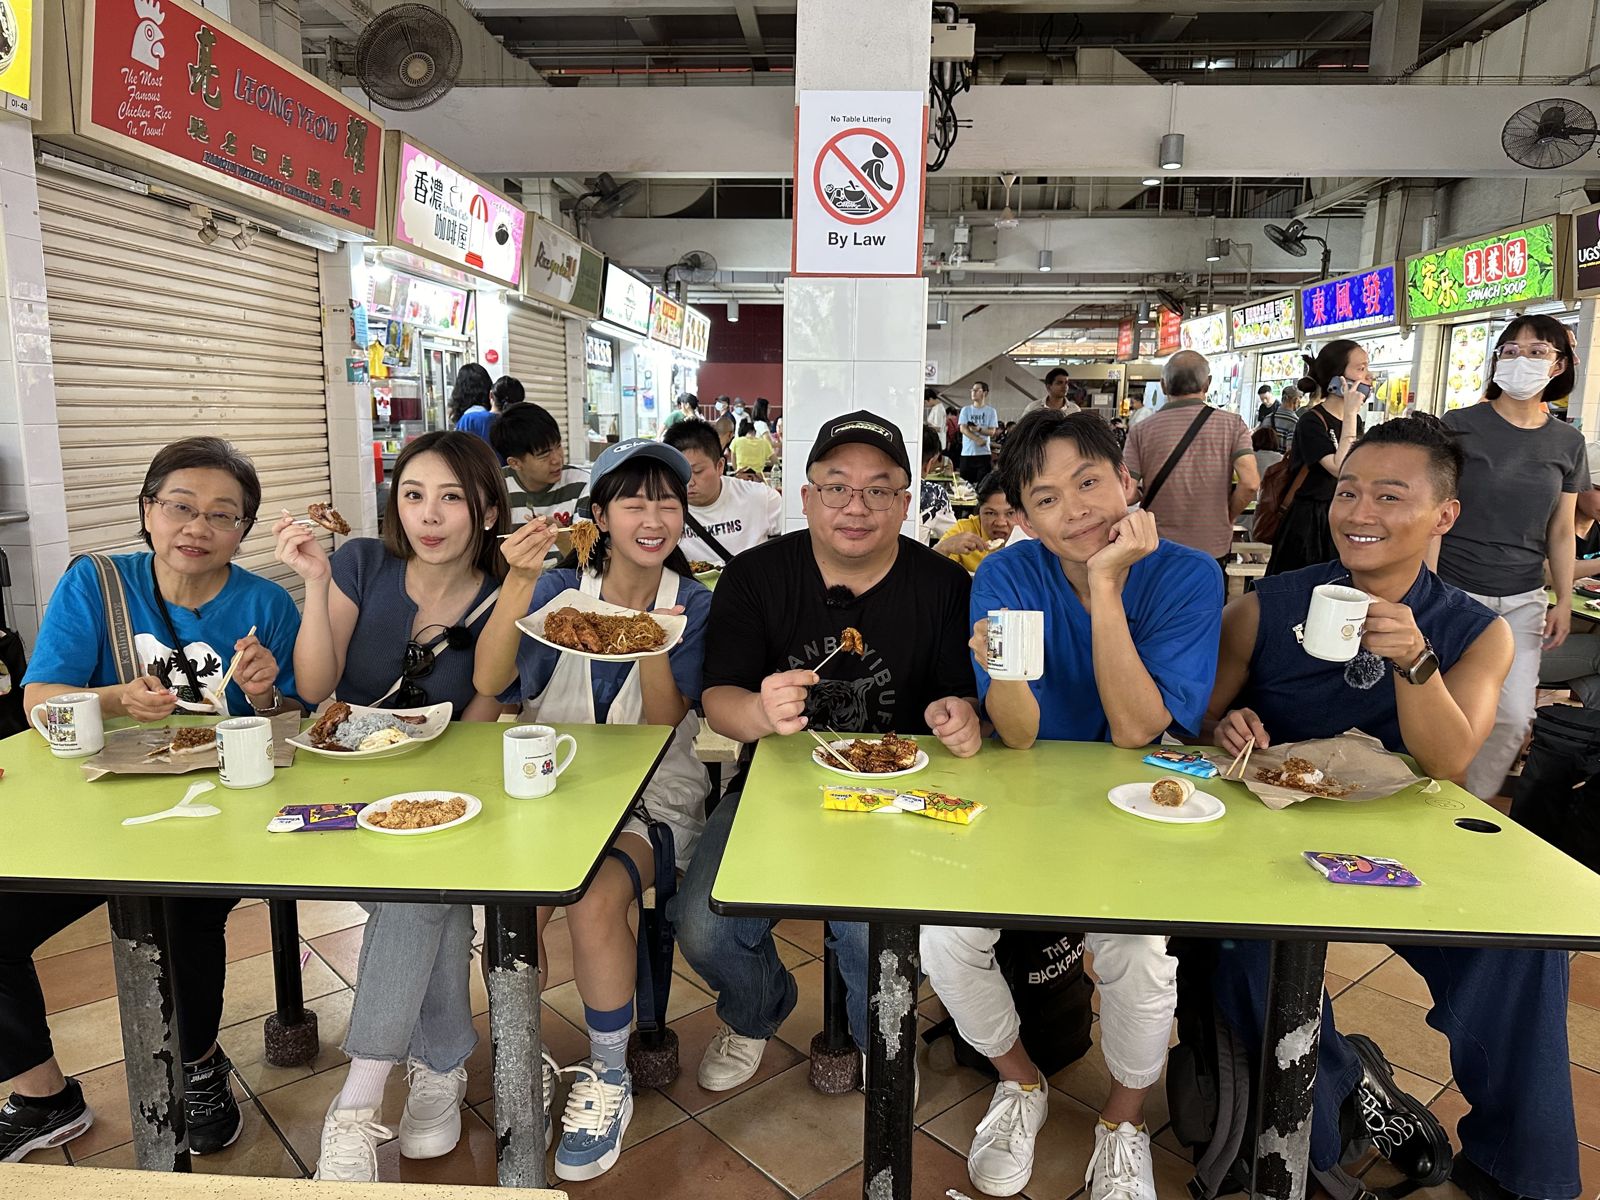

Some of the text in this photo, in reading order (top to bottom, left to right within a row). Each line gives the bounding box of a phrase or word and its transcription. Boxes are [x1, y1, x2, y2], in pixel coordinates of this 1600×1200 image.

[121, 68, 163, 87] The Most
[128, 85, 160, 102] Famous
[118, 101, 172, 119] Chicken Rice
[234, 68, 338, 144] LEONG YEOW
[127, 120, 166, 136] In Town!
[830, 115, 892, 124] No Table Littering
[434, 213, 468, 250] 咖啡屋
[828, 231, 886, 248] By Law
[1466, 279, 1527, 303] SPINACH SOUP
[1042, 936, 1071, 960] THE
